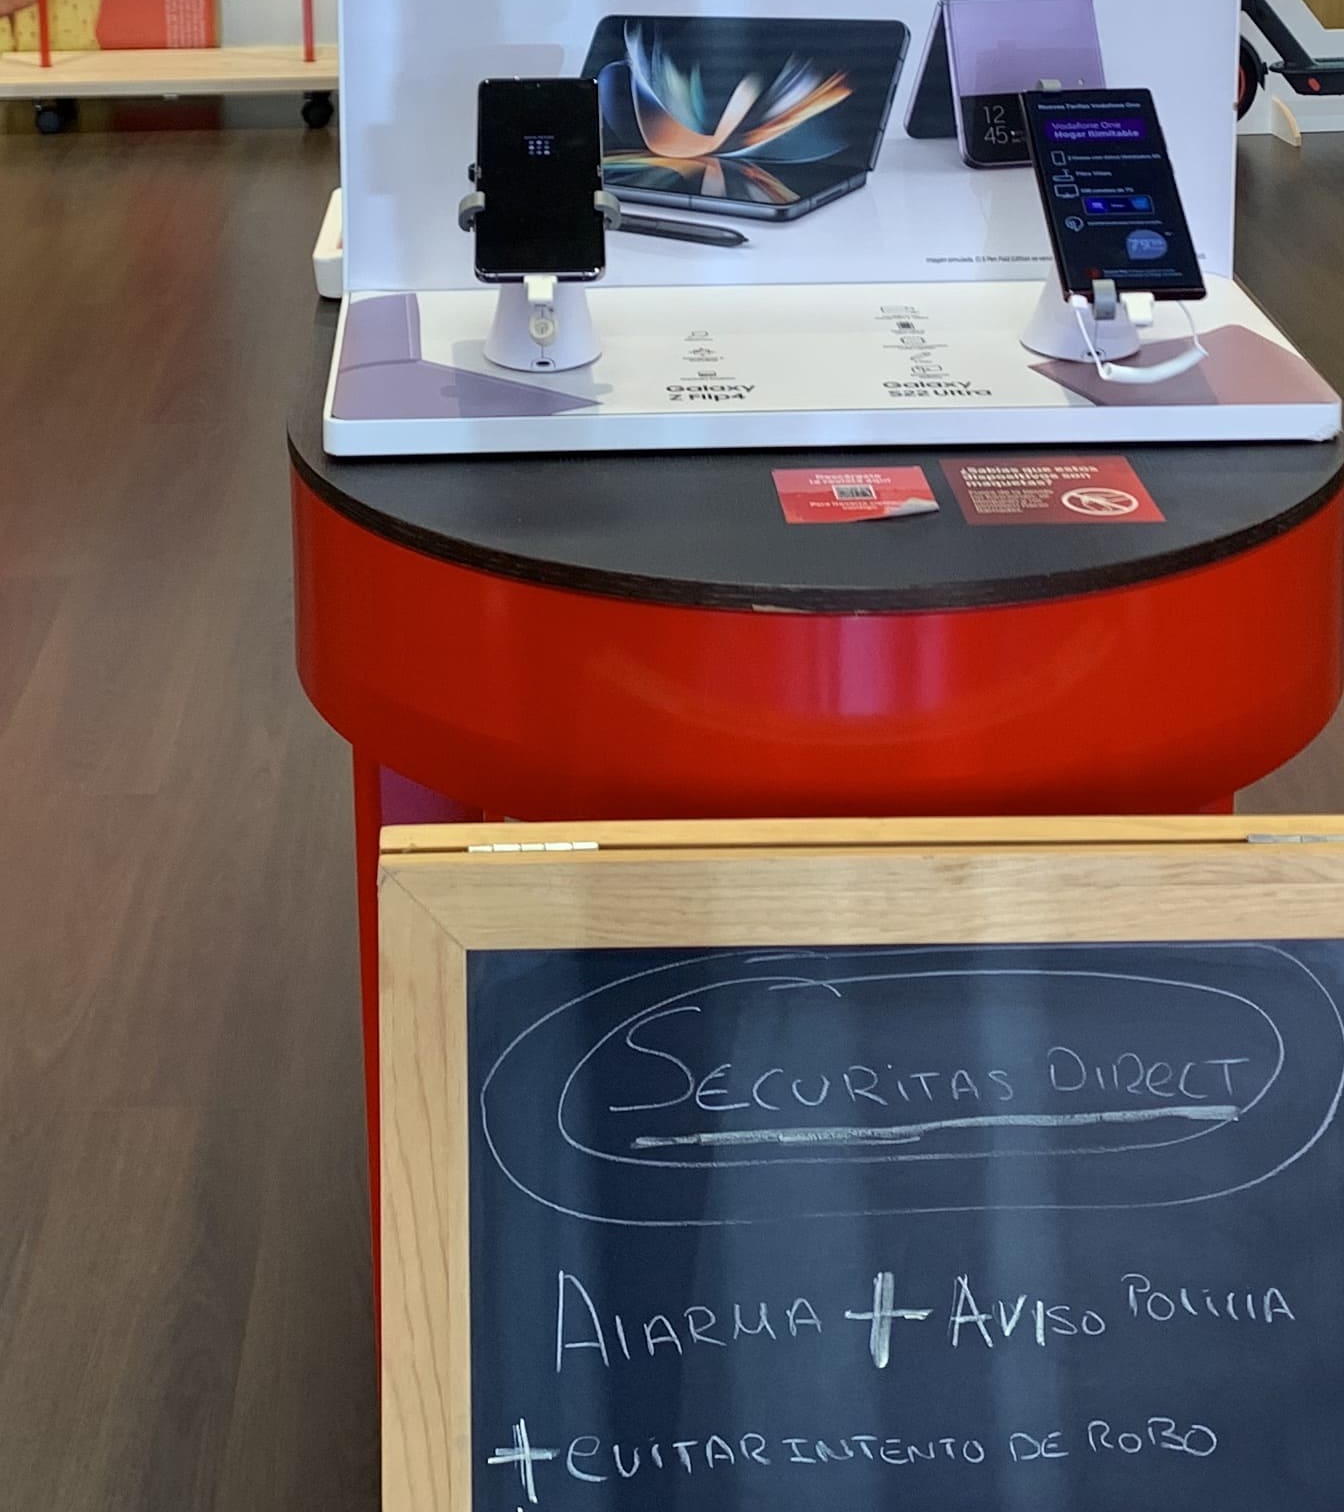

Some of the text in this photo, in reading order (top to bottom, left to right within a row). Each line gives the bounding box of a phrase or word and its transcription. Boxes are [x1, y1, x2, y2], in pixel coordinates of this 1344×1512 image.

[983, 104, 1006, 124] 12
[1051, 120, 1122, 131] Vodafone One
[983, 125, 1008, 144] 45
[1053, 130, 1085, 140] Hogar
[665, 384, 755, 394] Galaxy
[882, 380, 972, 390] Galaxy
[669, 391, 746, 402] Z Flip4
[887, 386, 992, 397] S22 Ultra
[843, 1270, 934, 1369] +
[947, 1272, 1106, 1349] AVISO
[486, 1417, 562, 1504] +
[781, 1432, 987, 1465] INTENTO
[1009, 1429, 1069, 1463] DE
[1086, 1415, 1218, 1458] ROBO
